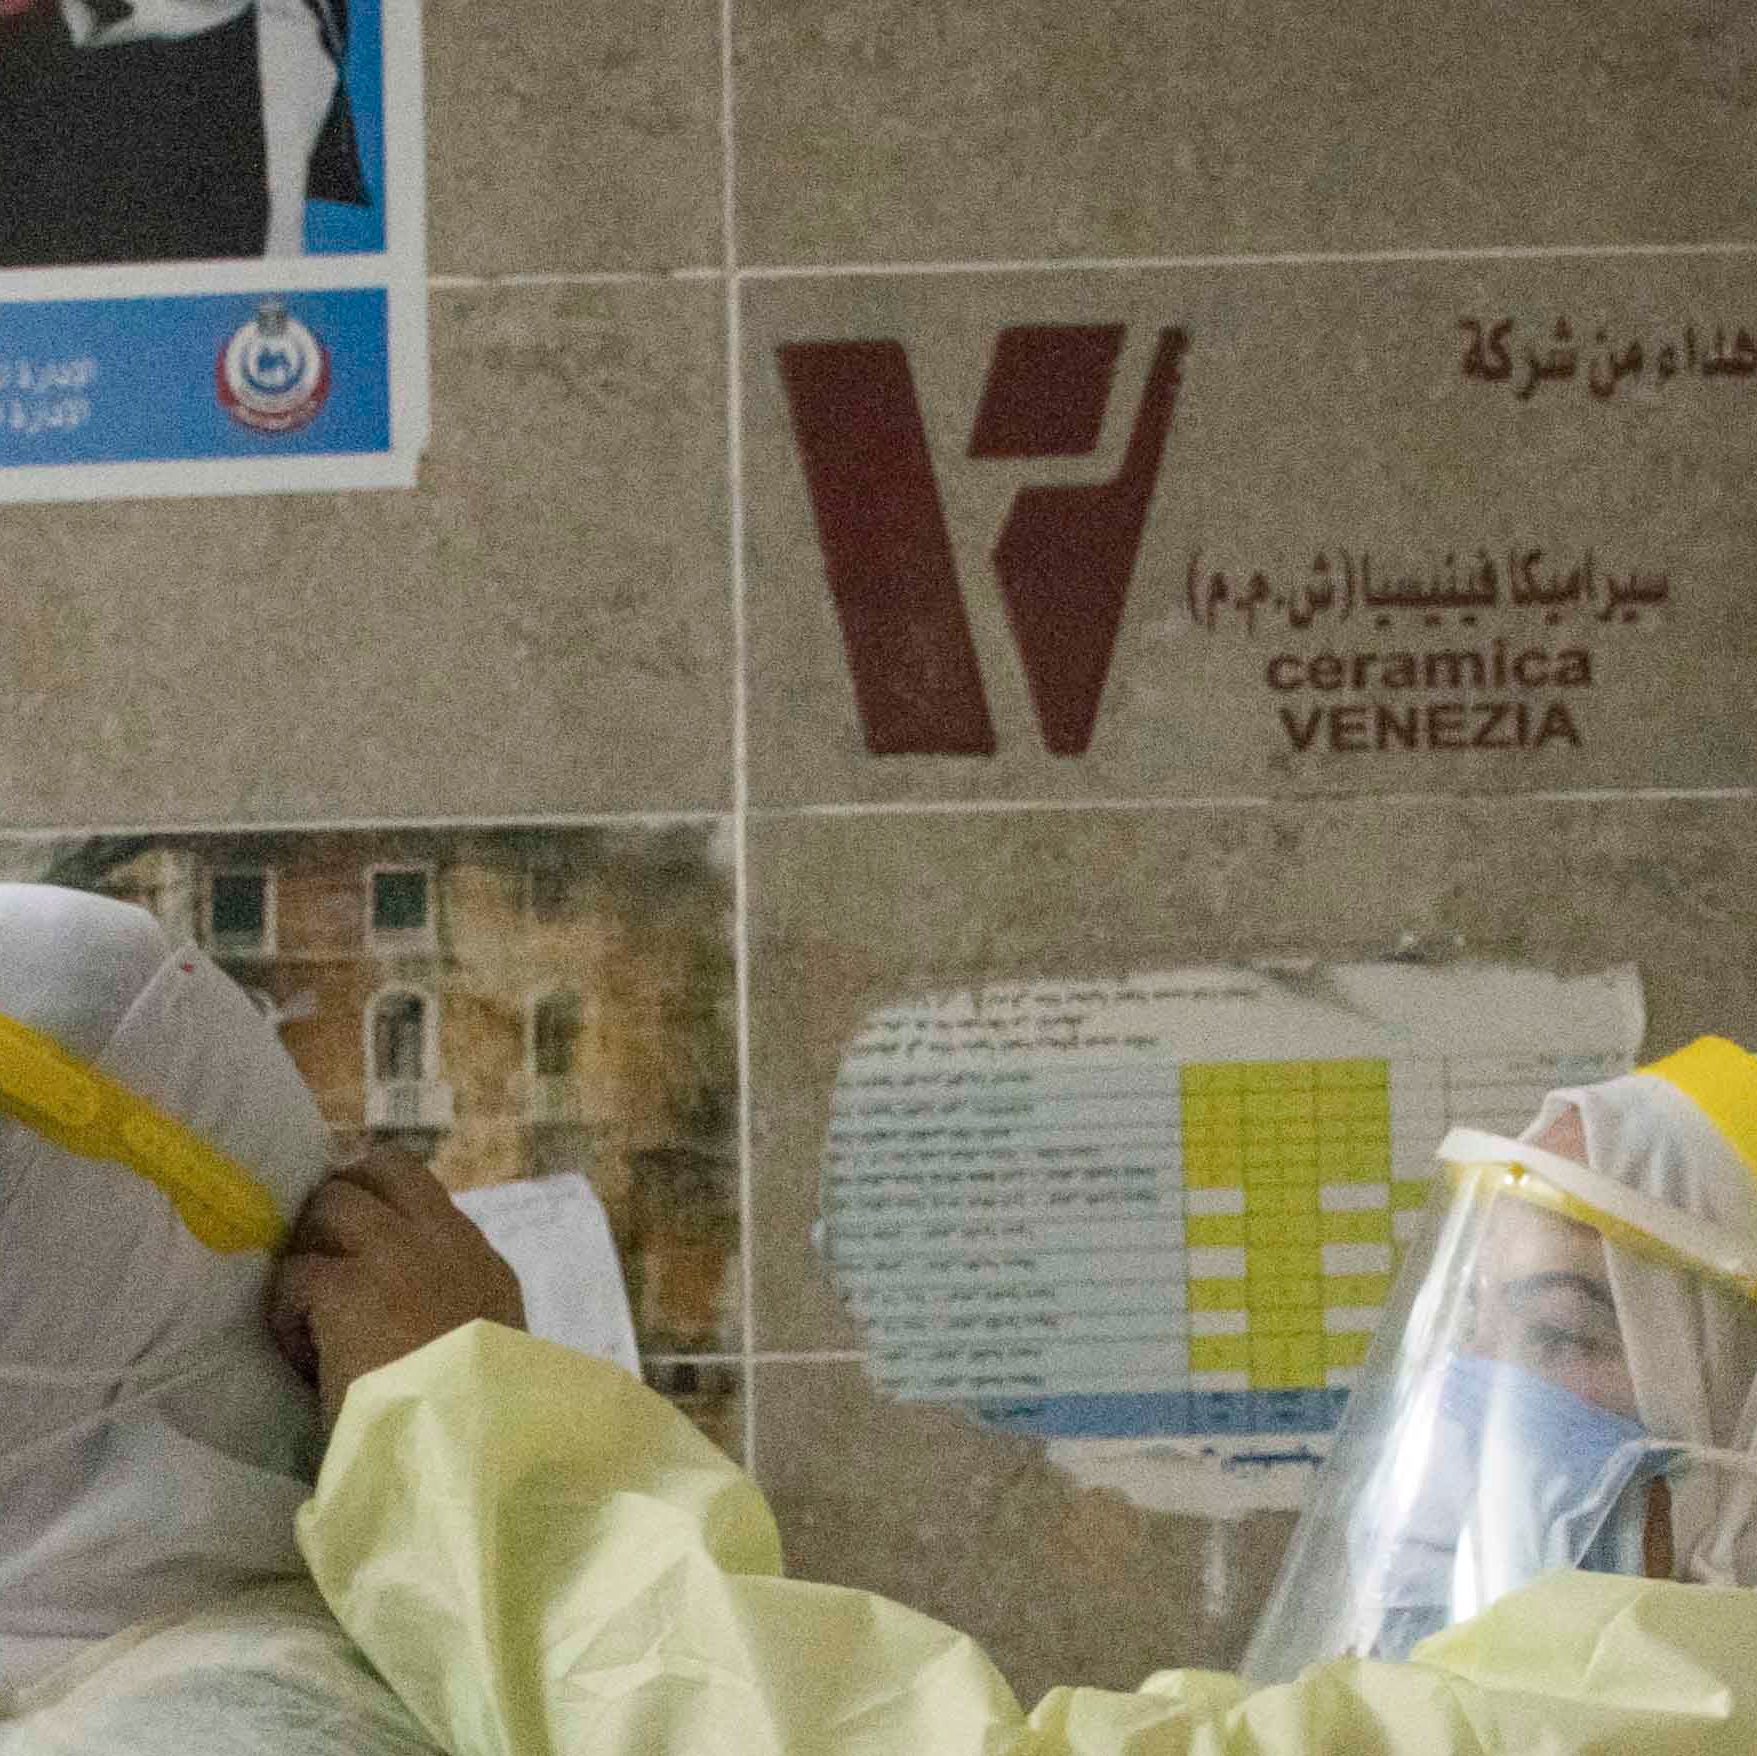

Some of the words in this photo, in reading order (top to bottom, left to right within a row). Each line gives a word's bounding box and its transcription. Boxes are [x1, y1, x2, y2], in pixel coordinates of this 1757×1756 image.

[1457, 316, 1576, 402] شركة
[1588, 330, 1642, 398] من
[1361, 550, 1500, 628] فينيسيا
[1508, 549, 1669, 625] سيراميكا
[1266, 638, 1592, 692] ceramica
[1278, 702, 1582, 754] VENEZIA
